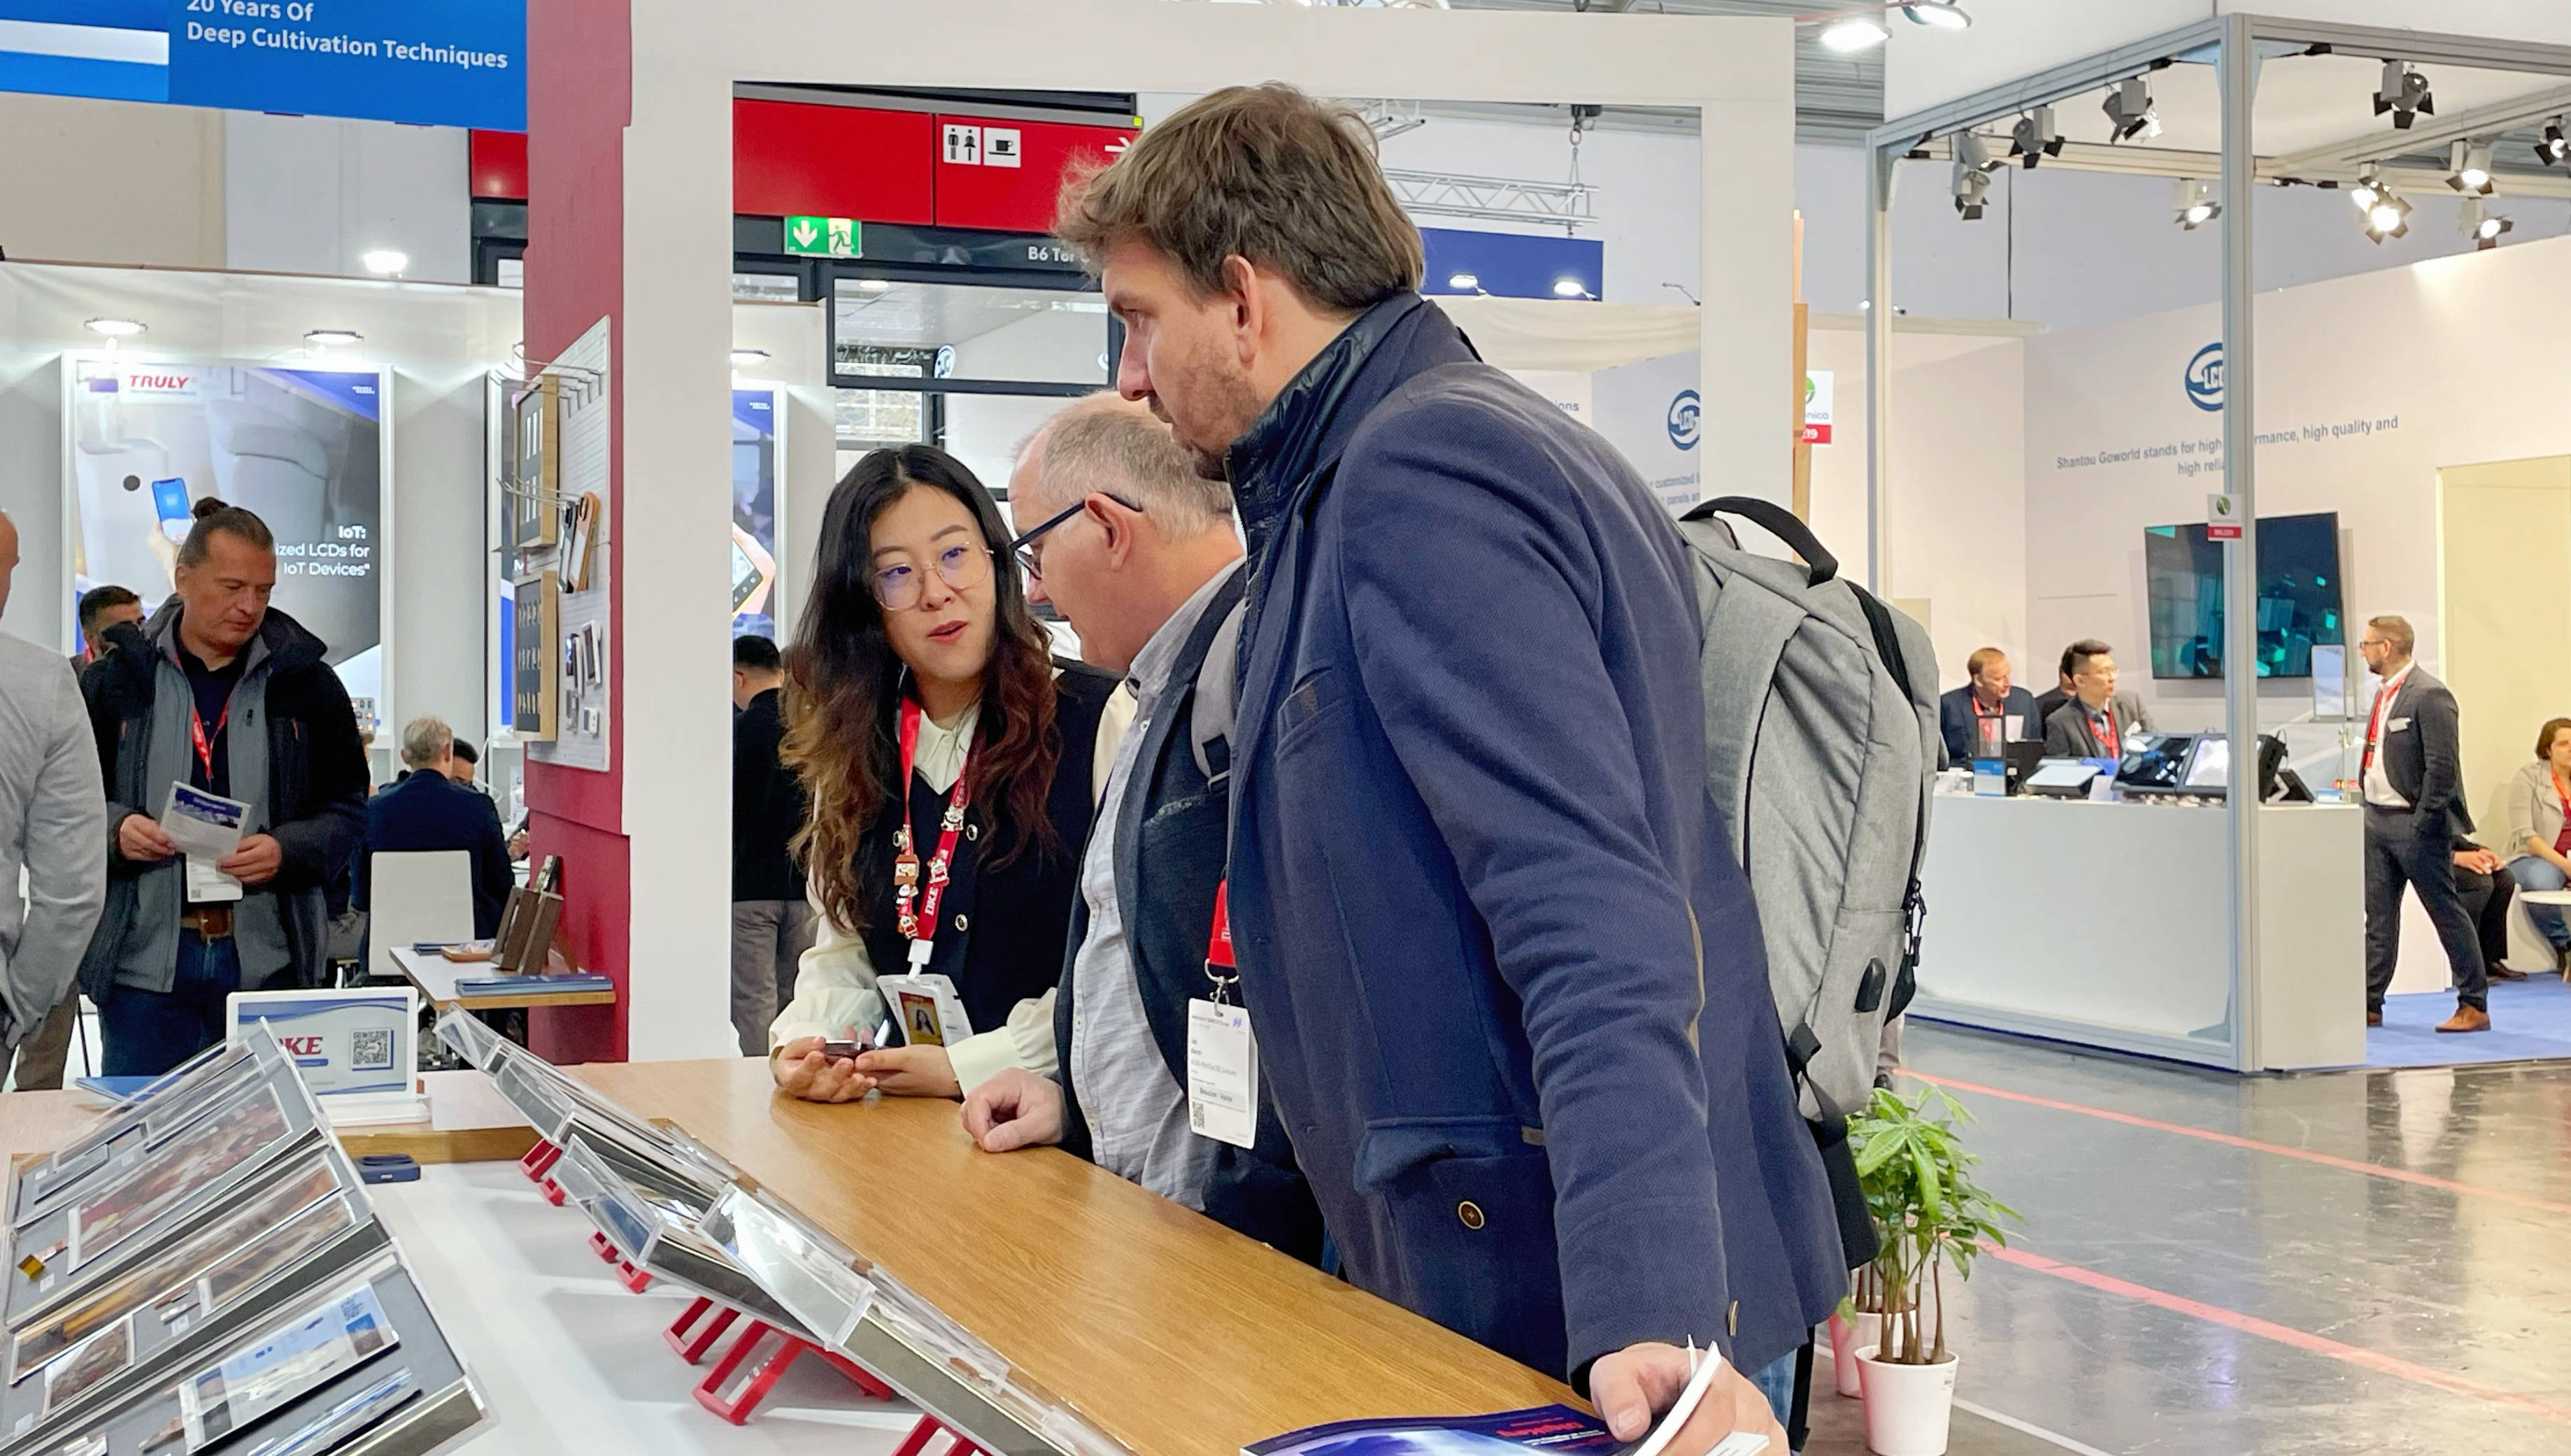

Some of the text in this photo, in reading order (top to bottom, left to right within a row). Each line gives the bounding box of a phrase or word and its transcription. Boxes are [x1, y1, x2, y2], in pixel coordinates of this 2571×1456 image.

[187, 0, 313, 22] 20 Years Of
[187, 21, 508, 69] Deep Cultivation Techniques
[1027, 245, 1048, 261] B6
[129, 375, 189, 389] TRULY
[2056, 415, 2399, 469] Shantou Goworld stands for high rmance, high quality and
[2178, 459, 2225, 478] high reli
[338, 524, 366, 540] IoT:
[275, 543, 370, 558] ized LCDs for
[283, 562, 306, 576] IoT
[279, 1036, 323, 1055] KE
